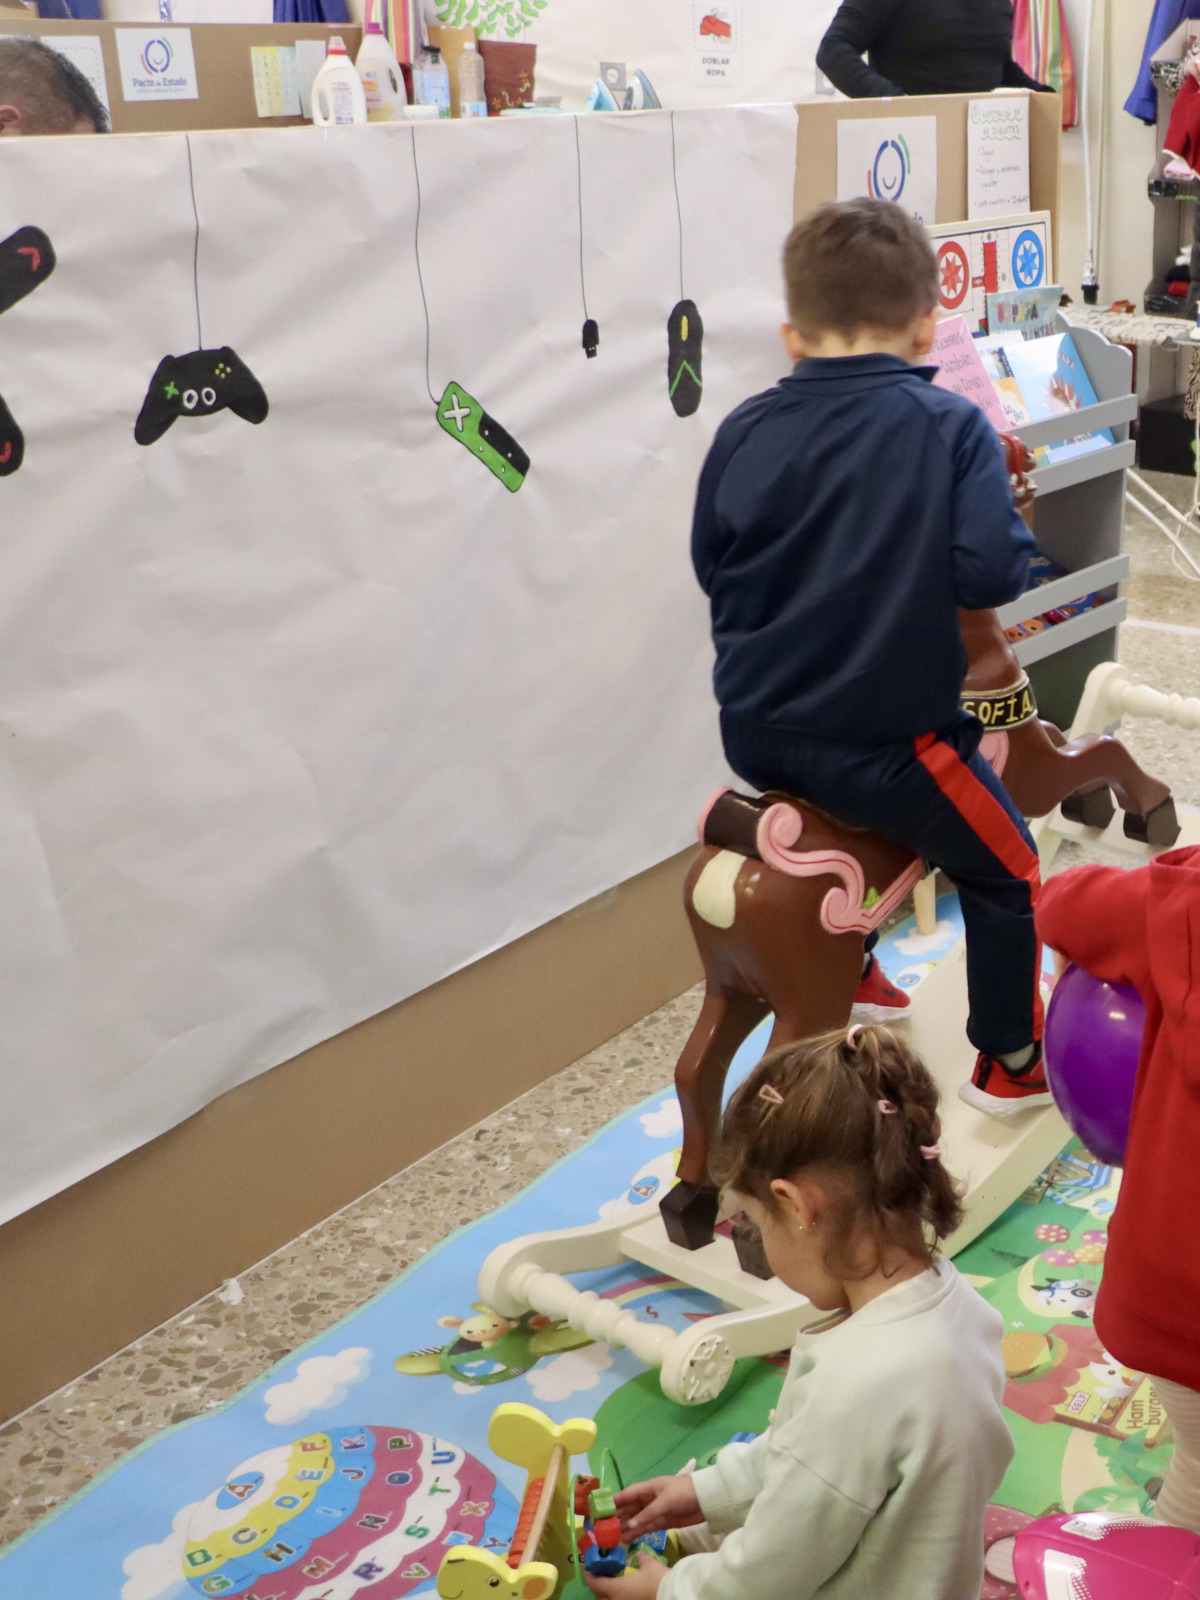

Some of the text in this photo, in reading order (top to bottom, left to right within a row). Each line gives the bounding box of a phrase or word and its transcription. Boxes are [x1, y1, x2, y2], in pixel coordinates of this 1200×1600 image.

[702, 57, 730, 65] DOBLAR
[706, 69, 726, 77] ROPA
[132, 77, 155, 87] Pacto
[162, 76, 188, 87] Estado
[1127, 1399, 1144, 1429] Ham
[431, 1451, 456, 1465] U
[227, 1484, 255, 1499] A
[404, 1524, 430, 1539] S
